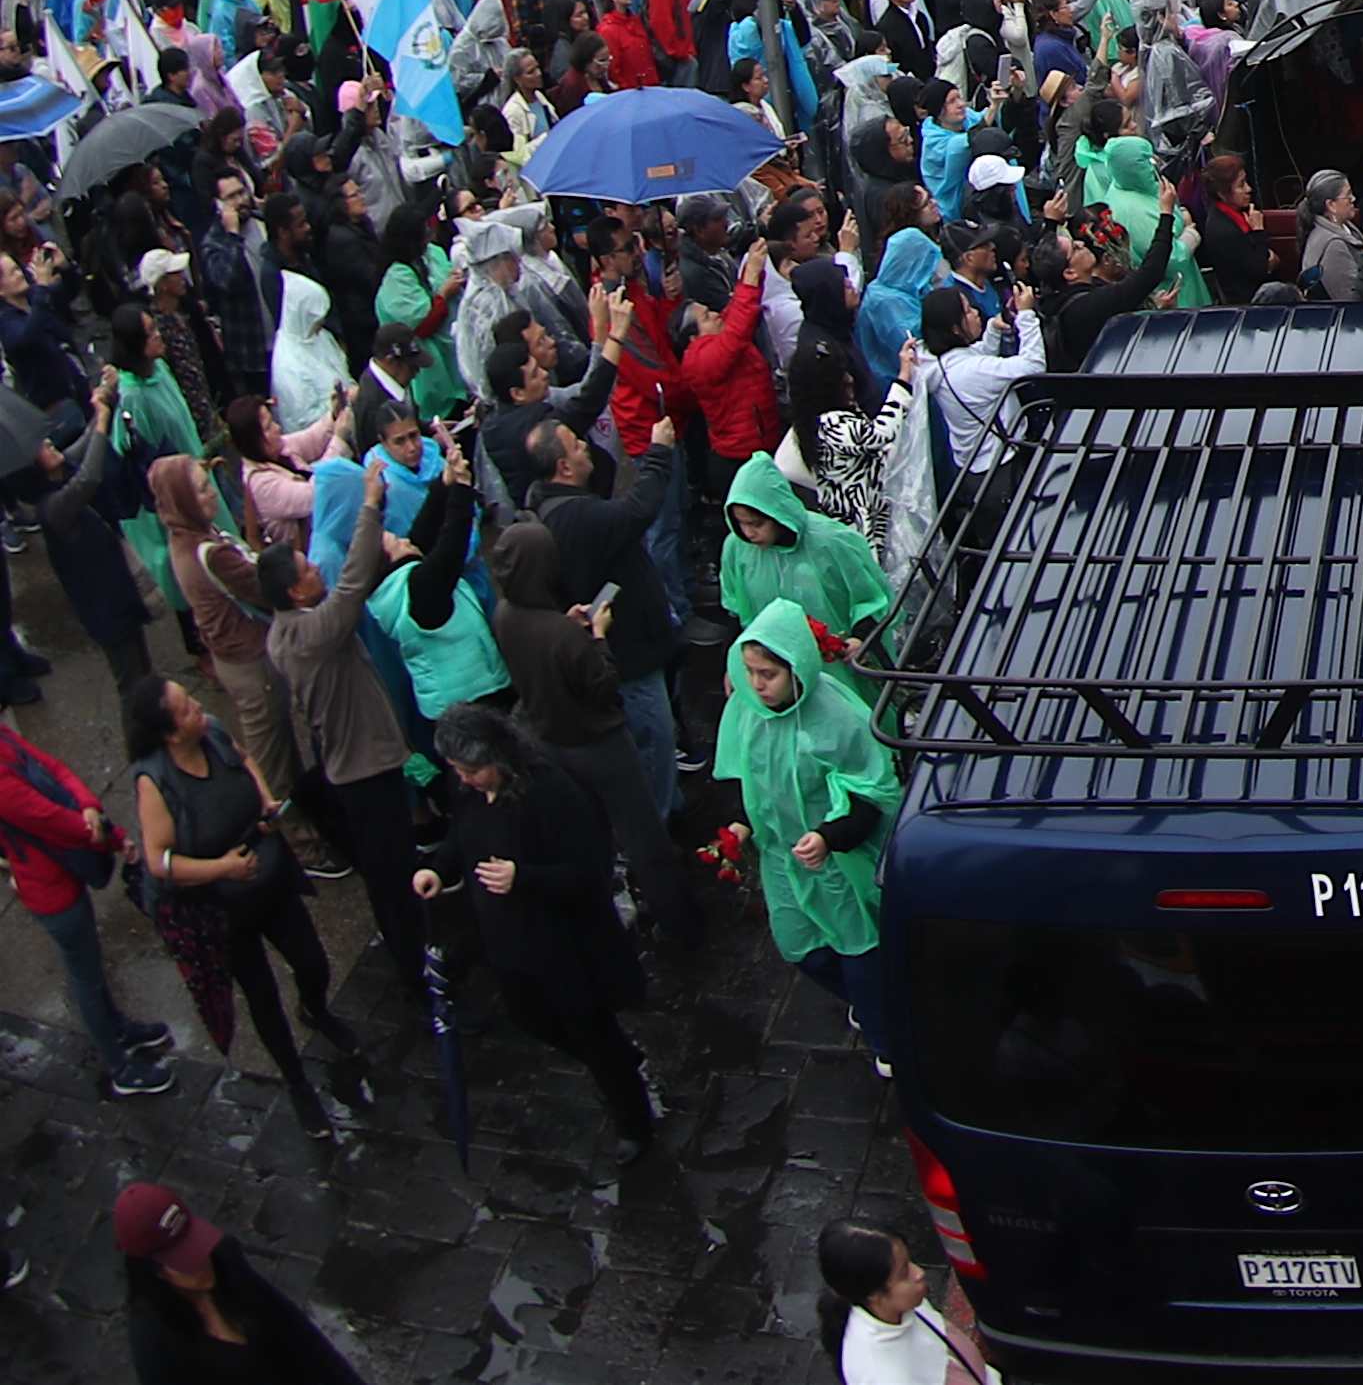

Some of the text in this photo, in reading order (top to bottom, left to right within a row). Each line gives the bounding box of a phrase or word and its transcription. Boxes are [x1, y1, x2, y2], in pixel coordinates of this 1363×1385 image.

[1311, 873, 1333, 917] P
[1243, 1260, 1355, 1284] P117GTV
[1289, 1289, 1339, 1297] TOYOTA
